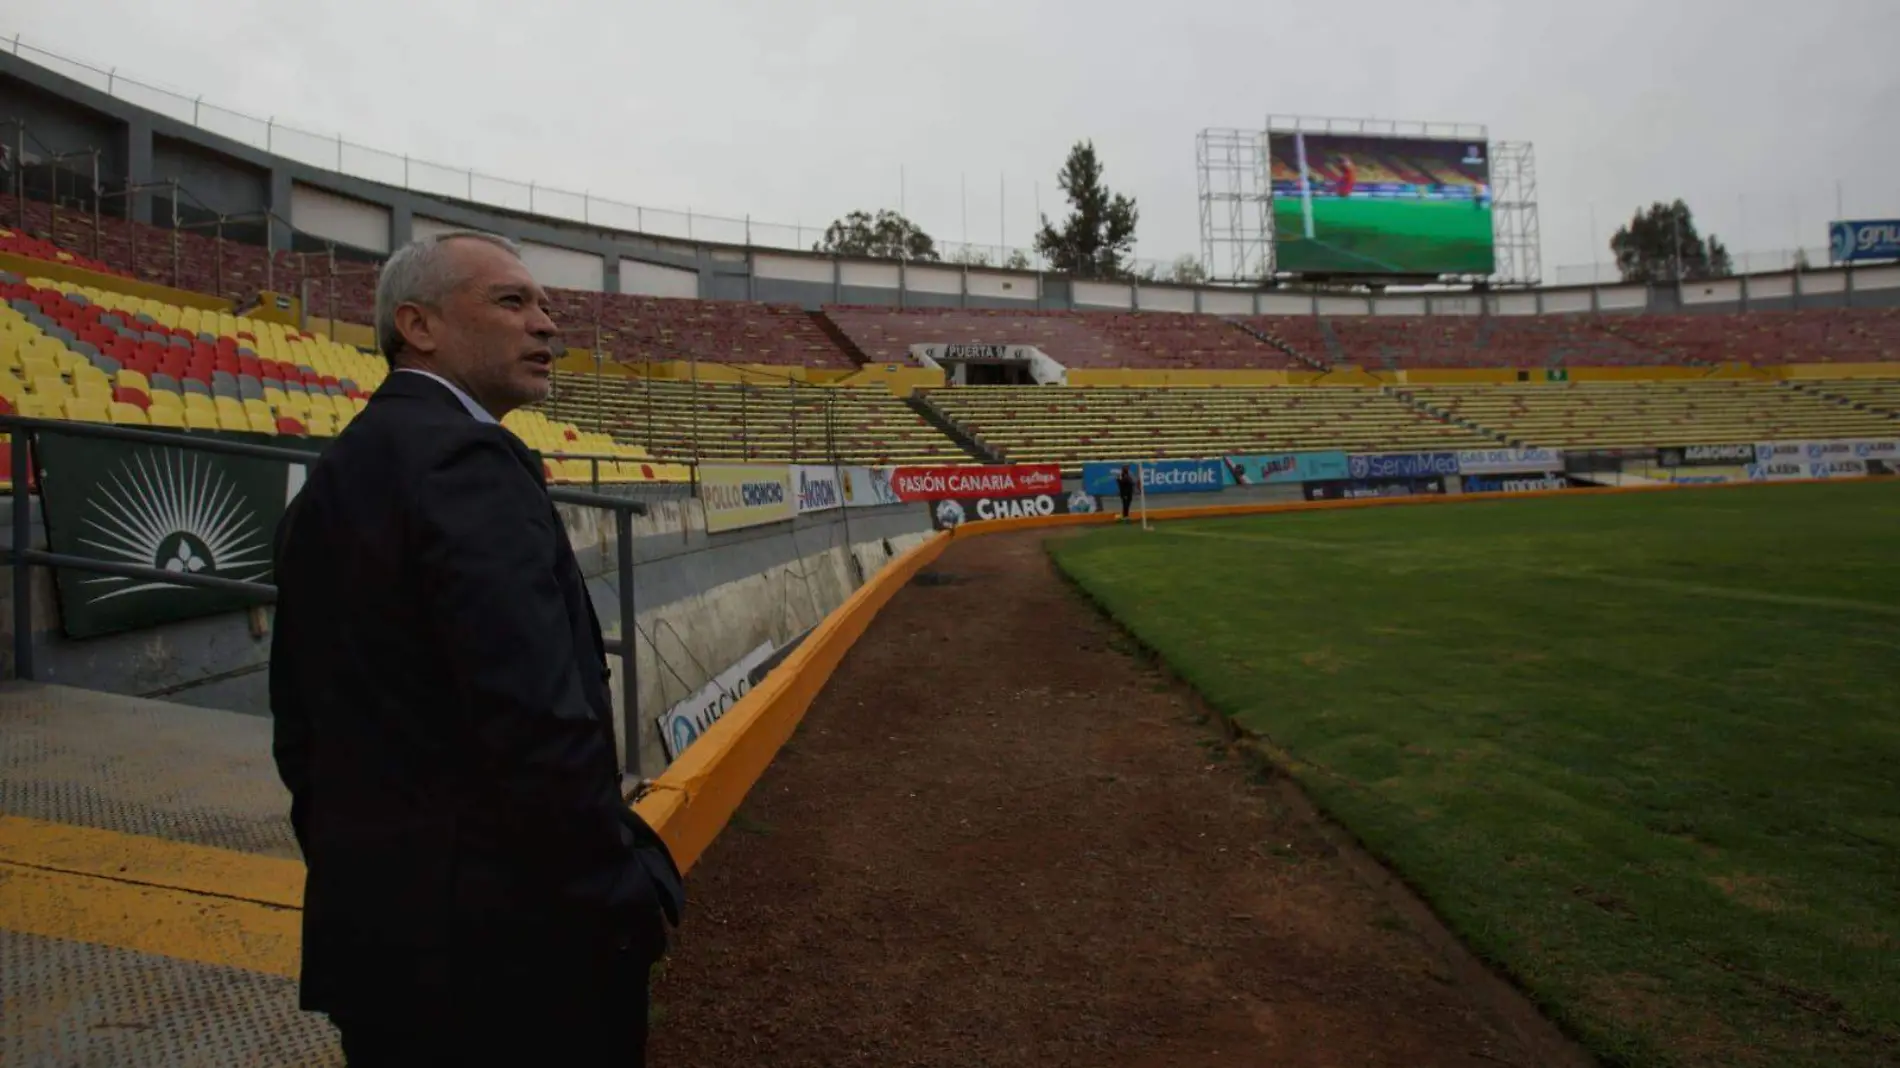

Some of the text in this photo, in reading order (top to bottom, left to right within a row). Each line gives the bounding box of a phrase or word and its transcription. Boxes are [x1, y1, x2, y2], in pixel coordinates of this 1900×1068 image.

[948, 344, 993, 358] PUERTA
[1141, 468, 1216, 485] Electrolit
[1369, 453, 1458, 477] ServiMed
[798, 470, 836, 510] AKRON
[899, 471, 946, 493] PASIÓN
[948, 473, 1015, 492] CANARIA
[703, 480, 784, 512] POLLO CHONCHO
[976, 494, 1055, 520] CHARO
